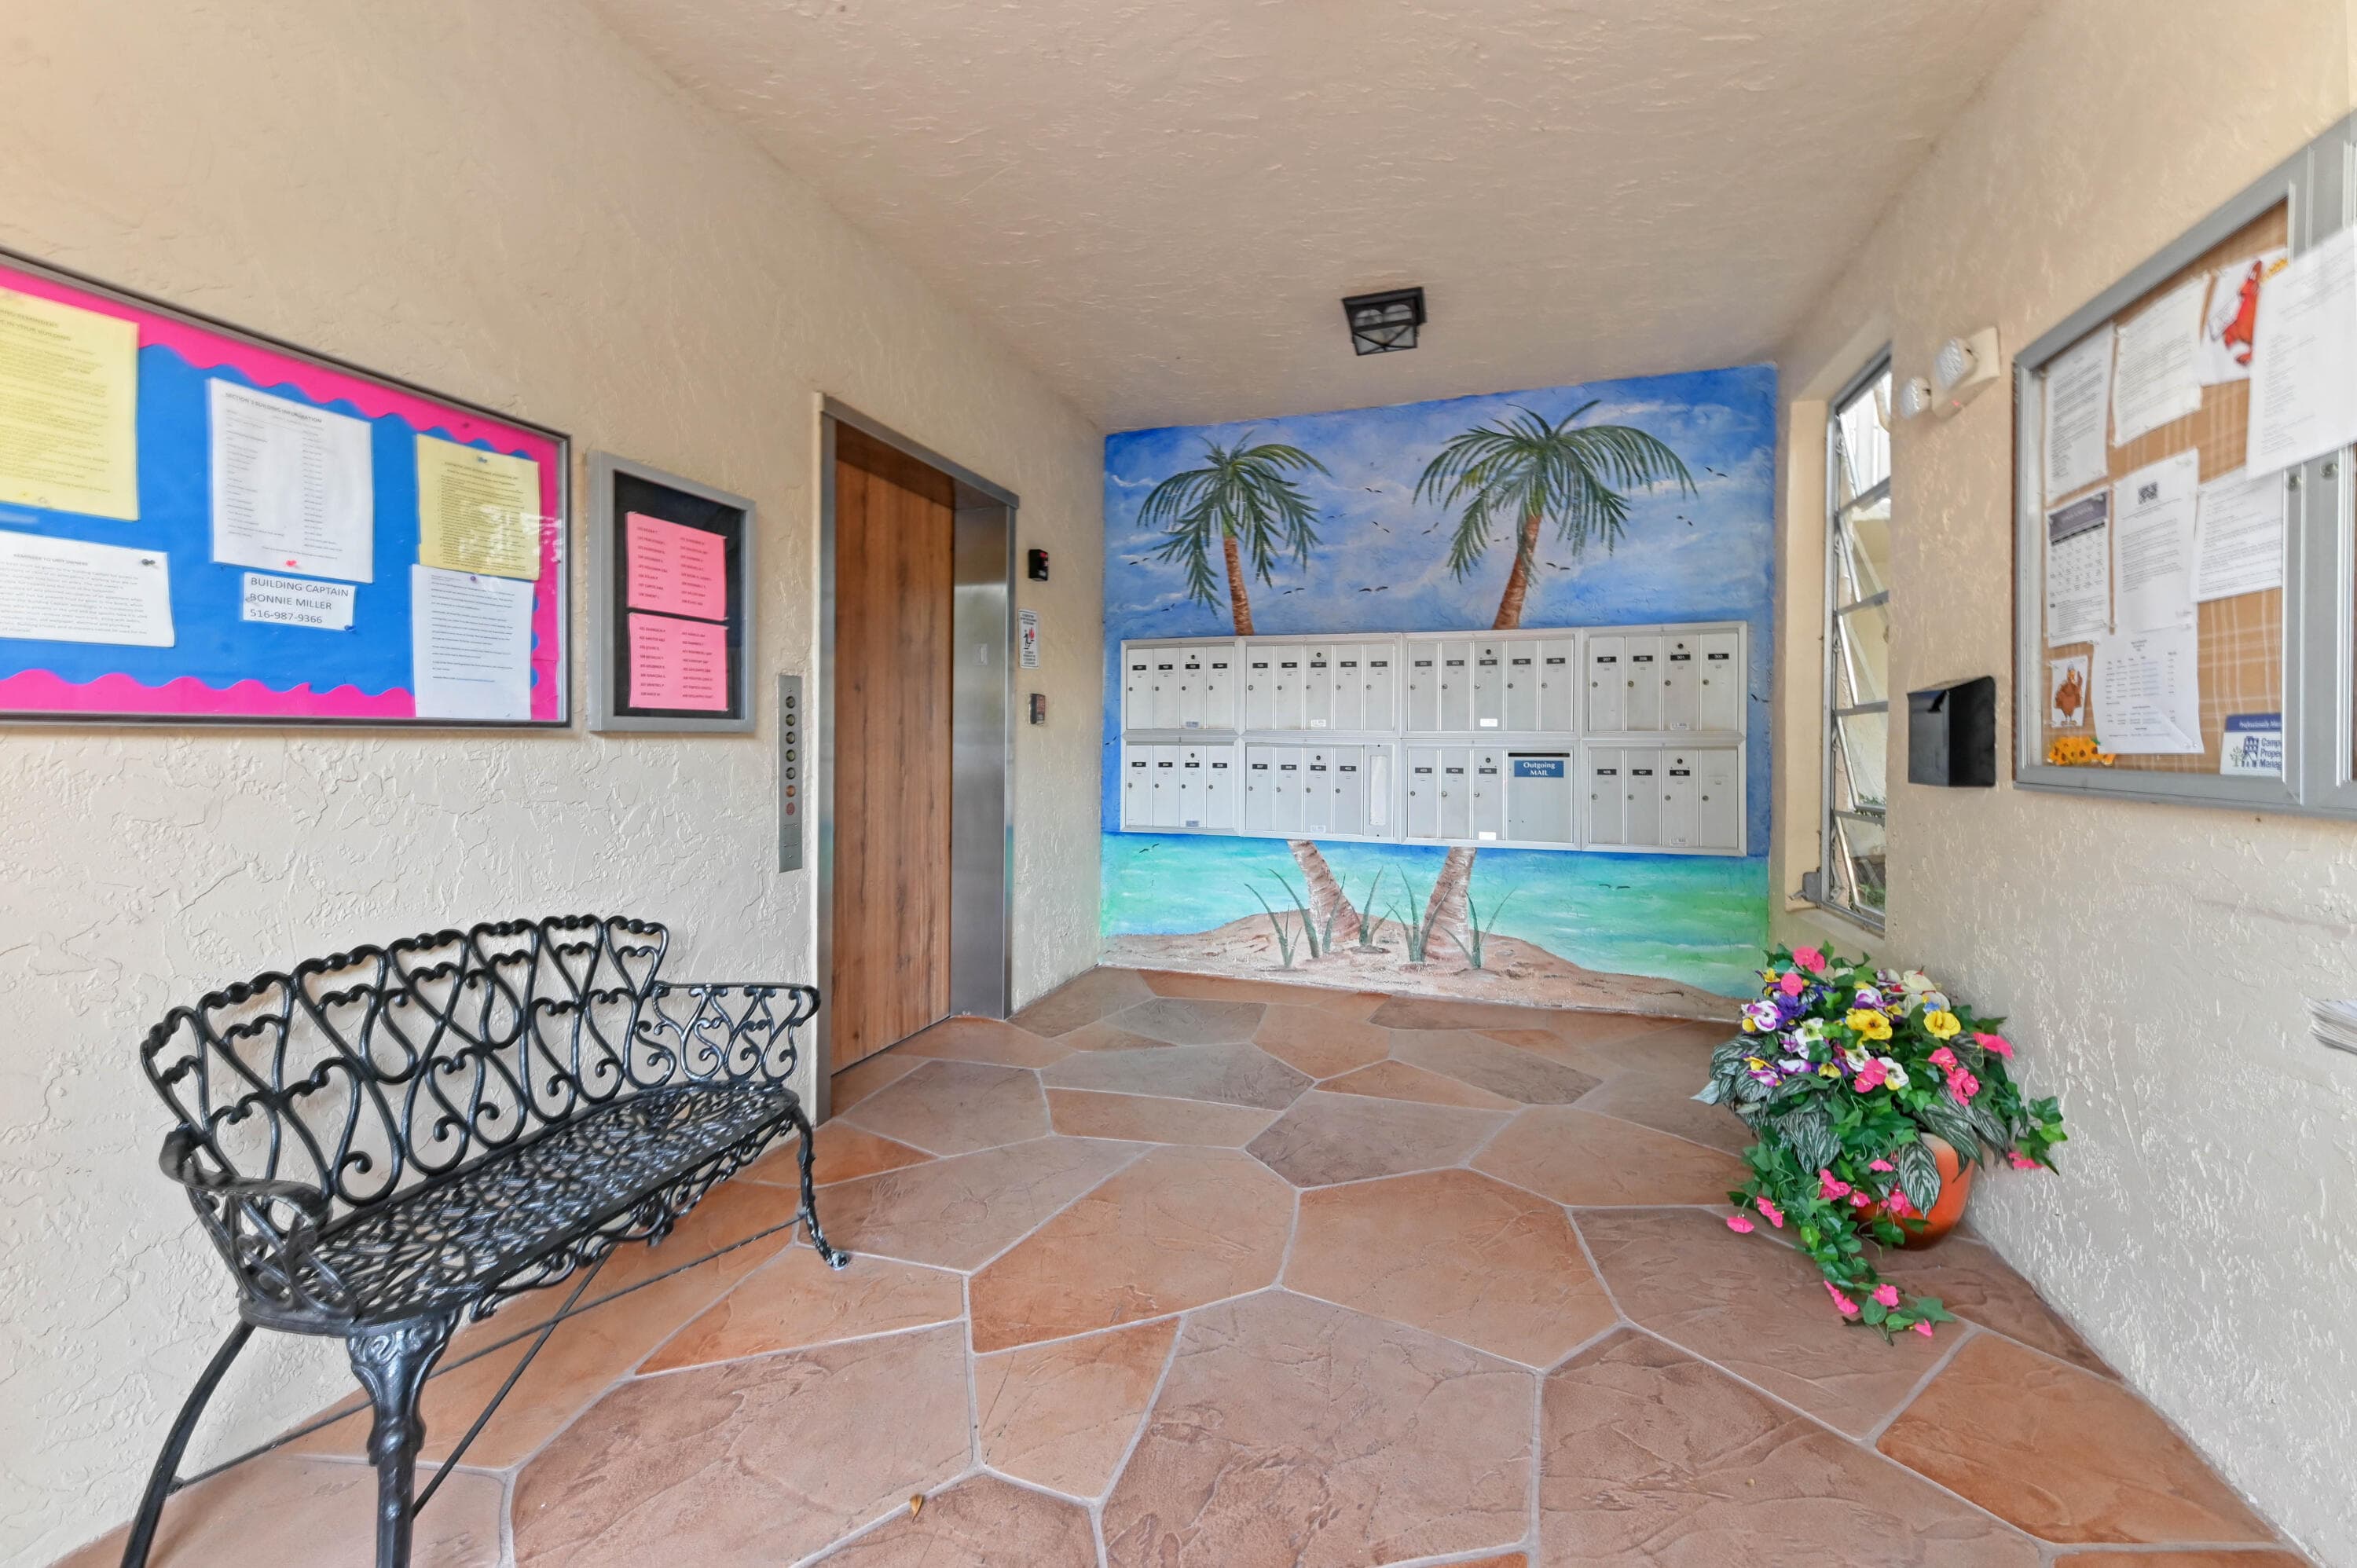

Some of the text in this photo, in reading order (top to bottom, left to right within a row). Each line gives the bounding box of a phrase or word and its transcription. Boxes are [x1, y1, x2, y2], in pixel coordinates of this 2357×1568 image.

[251, 577, 349, 597] BUILDING CAPTAIN
[250, 593, 332, 610] BONNIE MILLER
[250, 609, 323, 624] 516-987-9366
[1523, 761, 1556, 770] Outgoing
